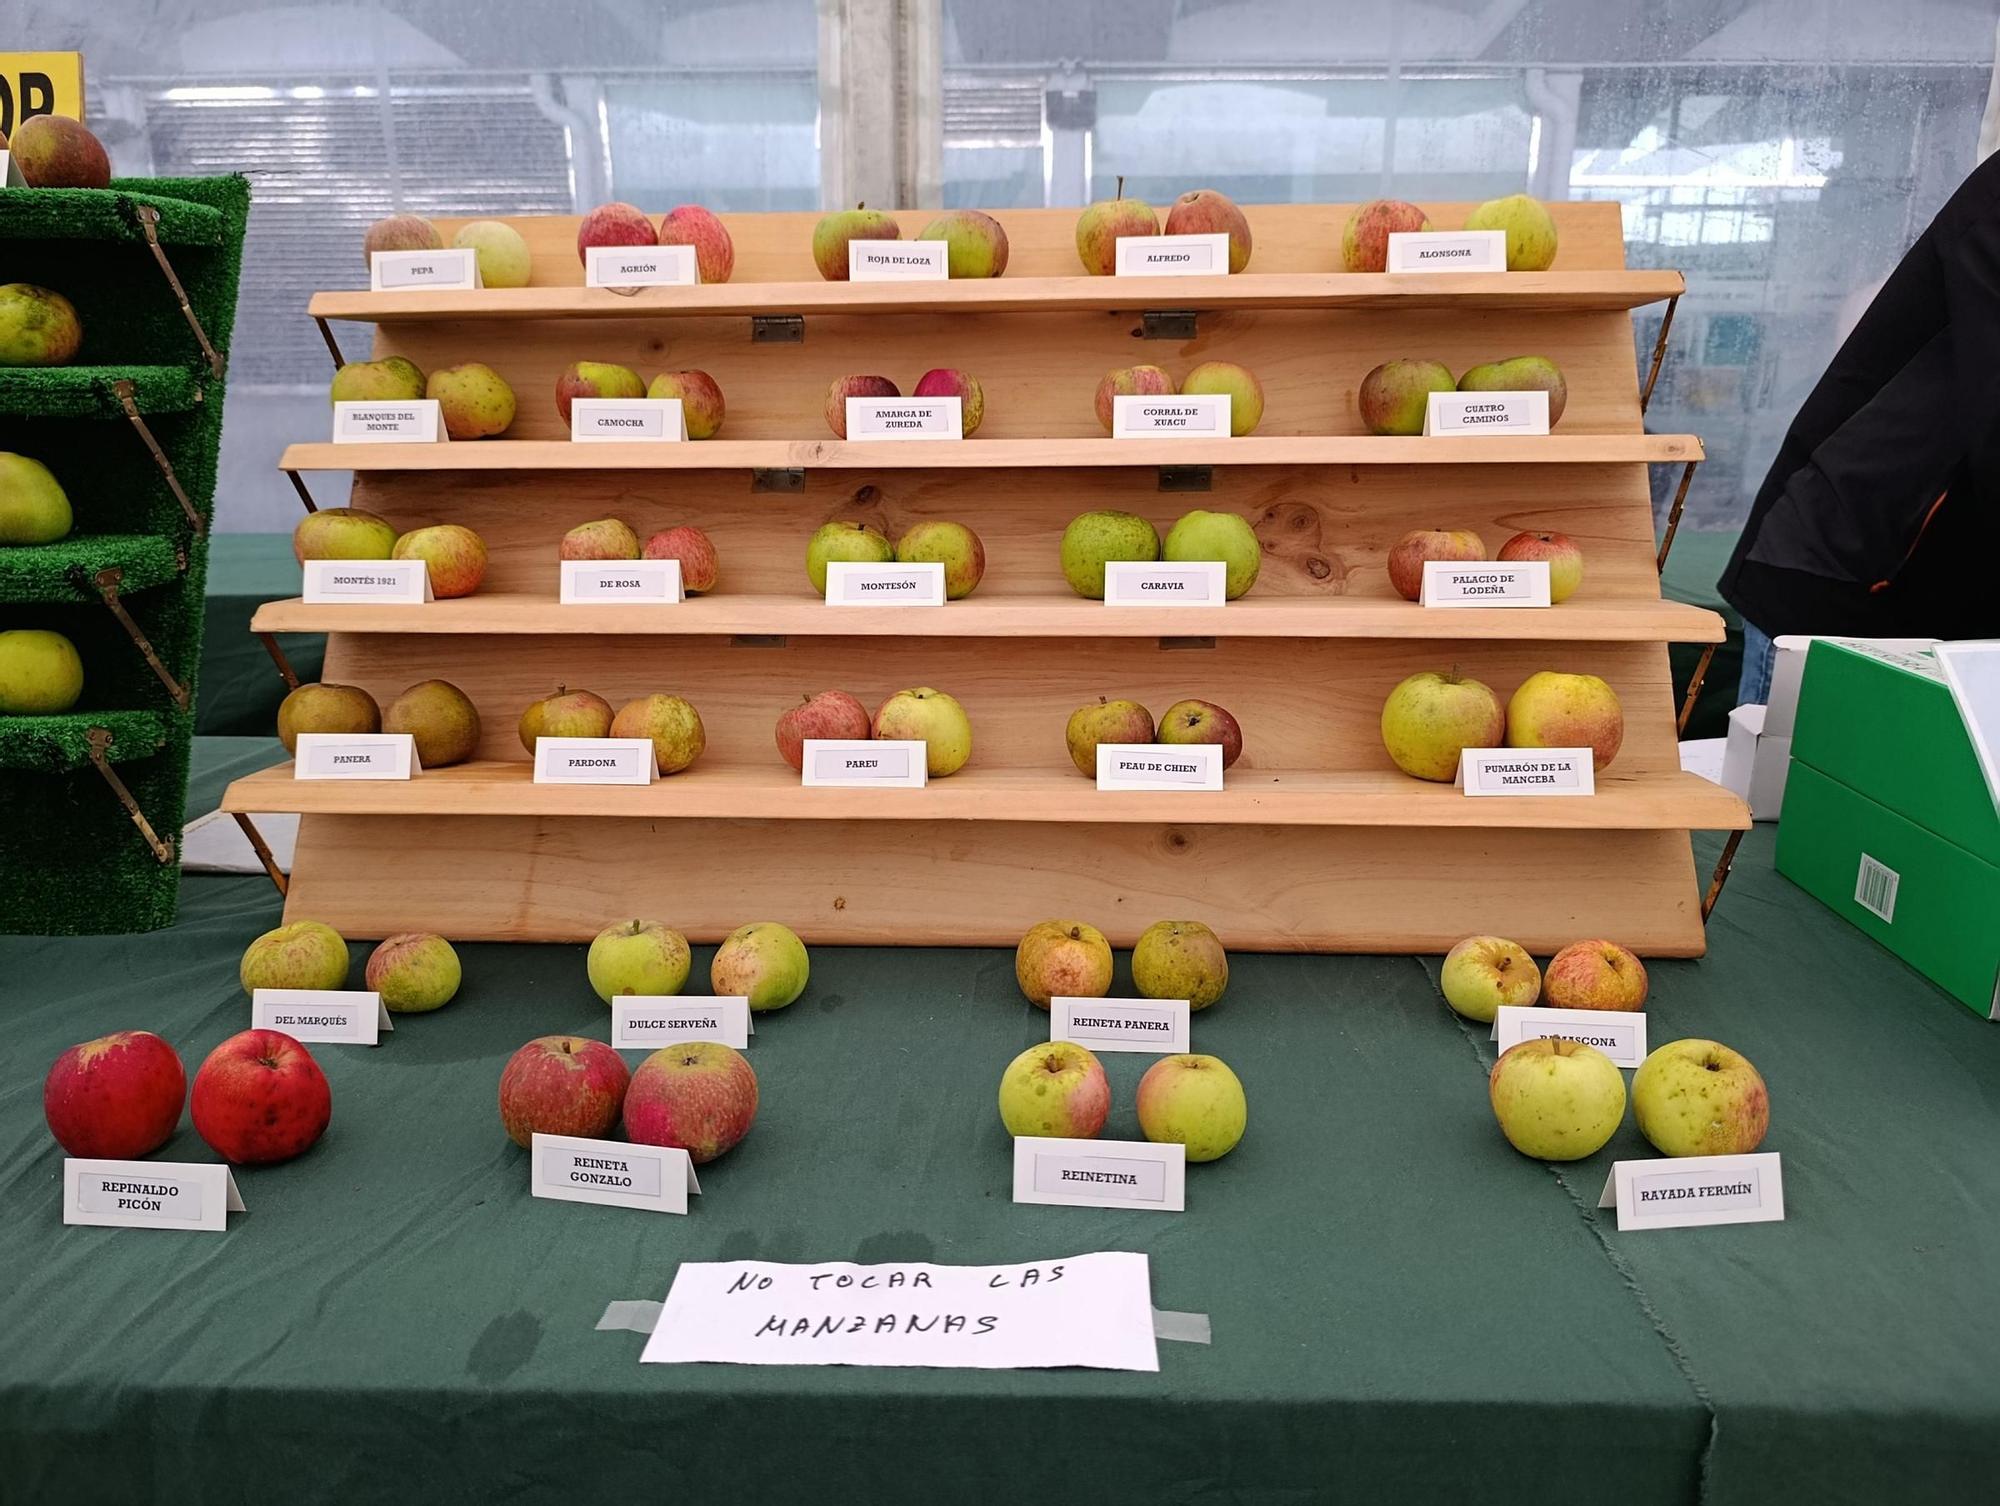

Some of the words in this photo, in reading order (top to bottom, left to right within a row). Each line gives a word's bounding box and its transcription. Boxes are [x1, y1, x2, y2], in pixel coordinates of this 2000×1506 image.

[1147, 254, 1191, 263] ALFREDO
[1419, 249, 1472, 259] ALONSONA
[867, 255, 891, 265] ROJA
[892, 256, 906, 265] DE
[906, 257, 931, 266] LOZA
[410, 266, 435, 276] PEPA
[620, 263, 657, 274] AGRIÓN
[1143, 408, 1183, 416] CORRAL
[1184, 408, 1198, 416] DE
[1464, 404, 1505, 414] CUATRO
[352, 413, 397, 422] BLANQUES
[397, 412, 416, 421] DEL
[875, 410, 917, 419] AMARGA
[918, 410, 932, 418] DE
[1462, 414, 1509, 424] CAMINOS
[366, 423, 400, 431] MONTE
[597, 418, 645, 427] CAMOCHA
[885, 420, 923, 429] ZUREDA
[1154, 418, 1187, 427] XUACU
[333, 576, 376, 585] MONTÉS
[377, 577, 396, 586] 1921
[599, 580, 614, 588] DE
[615, 580, 641, 588] ROSA
[1452, 575, 1498, 584] PALACIO
[1499, 574, 1515, 583] DE
[860, 580, 917, 591] MONTESÓN
[1140, 582, 1185, 590] CARAVIA
[1462, 584, 1506, 595] LODEÑA
[333, 755, 372, 764] PANERA
[568, 759, 617, 767] PARDONA
[845, 759, 878, 769] PAREU
[1119, 761, 1146, 771] PEAU
[1147, 763, 1163, 772] DE
[1163, 763, 1198, 773] CHIEN
[1484, 762, 1539, 774] PUMARÓN
[1540, 763, 1556, 772] DE
[1557, 762, 1572, 771] LA
[1501, 775, 1556, 785] MANCEBA
[274, 1015, 296, 1025] DEL
[297, 1015, 347, 1028] MARQUÉS
[628, 1020, 666, 1029] DULCE
[667, 1017, 718, 1029] SERVEÑA
[1072, 1017, 1122, 1029] REINETA
[1124, 1020, 1170, 1031] PANERA
[573, 1156, 629, 1172] REINETA
[569, 1171, 632, 1187] GONZALO
[1061, 1169, 1138, 1185] REINETINA
[101, 1181, 179, 1197] REPINALDO
[1640, 1187, 1696, 1202] RAYADA
[1698, 1181, 1752, 1198] FERMÍN
[118, 1198, 162, 1211] PICÓN
[727, 1271, 773, 1294] NO
[810, 1272, 932, 1289] TOCAR
[988, 1266, 1065, 1288] LAS
[755, 1314, 999, 1338] MANZANAS
